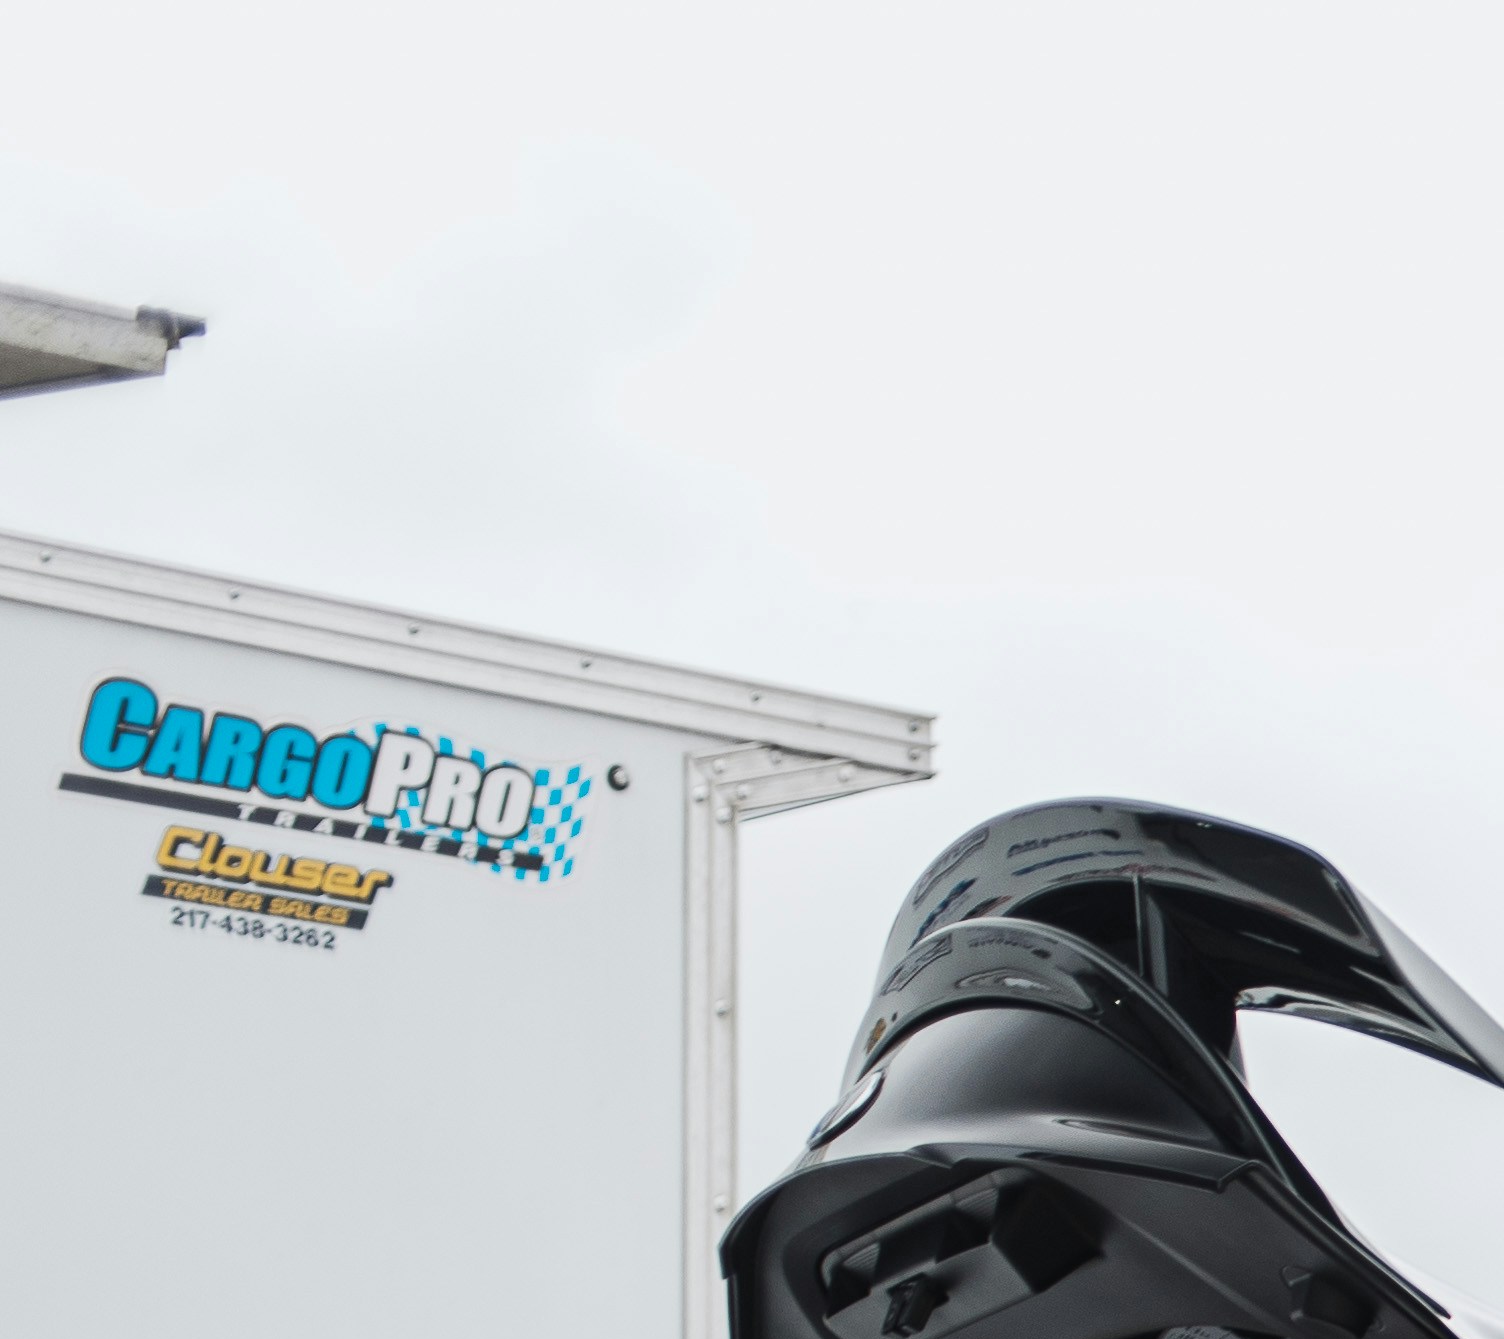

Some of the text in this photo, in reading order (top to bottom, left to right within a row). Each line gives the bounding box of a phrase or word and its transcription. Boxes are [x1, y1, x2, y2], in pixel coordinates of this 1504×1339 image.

[156, 825, 394, 905] Clouser
[236, 803, 515, 866] TRAILERS
[161, 879, 350, 926] TRAILER SALES
